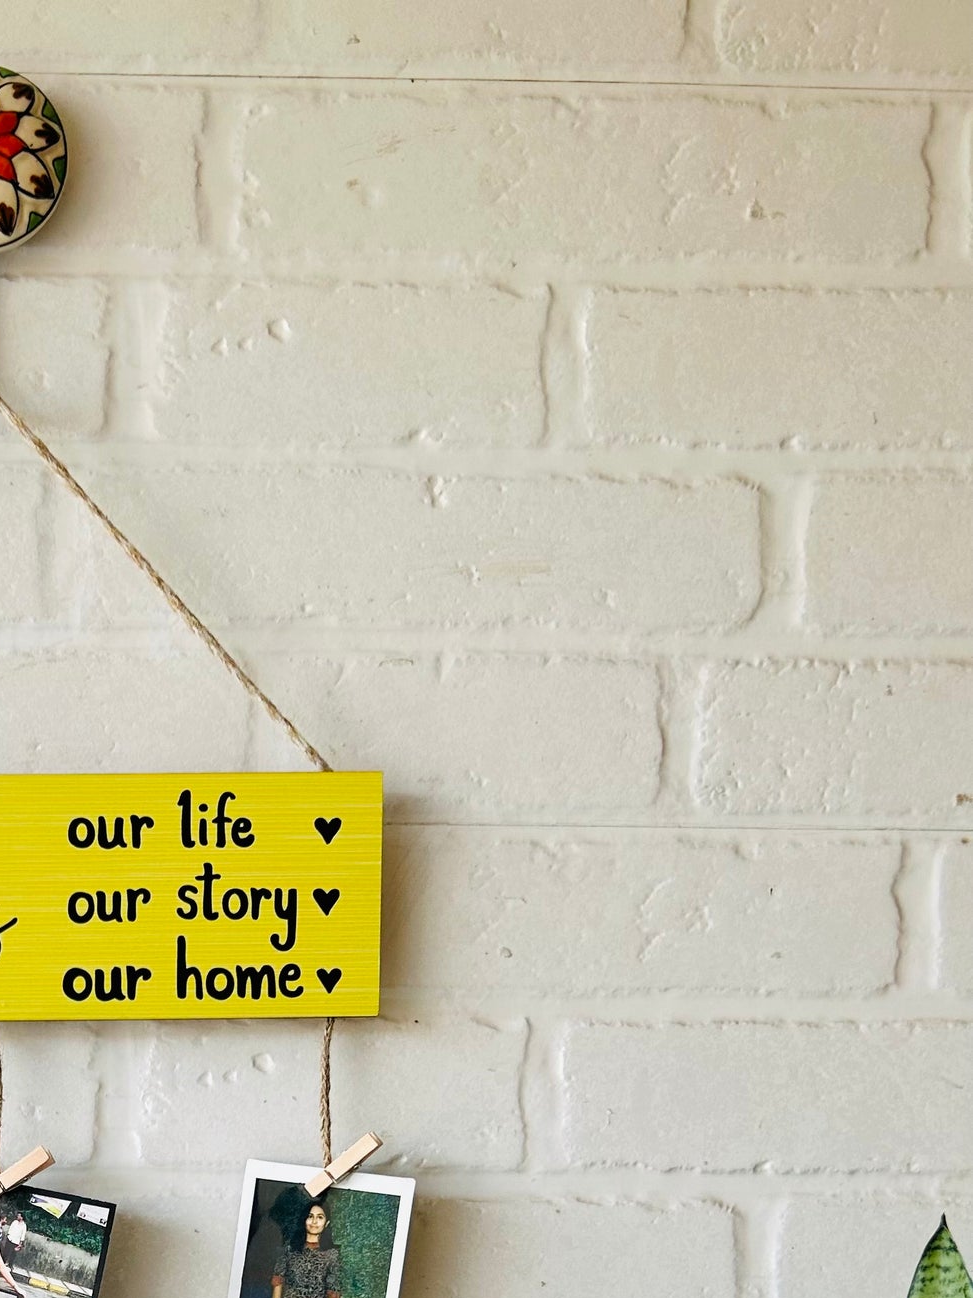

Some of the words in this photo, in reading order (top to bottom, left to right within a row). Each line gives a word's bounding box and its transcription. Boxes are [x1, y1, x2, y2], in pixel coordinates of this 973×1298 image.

[67, 814, 155, 850] our
[177, 789, 255, 849] life
[67, 887, 151, 924] our
[176, 862, 298, 952] story
[62, 965, 152, 1002] our
[176, 935, 304, 1001] home
